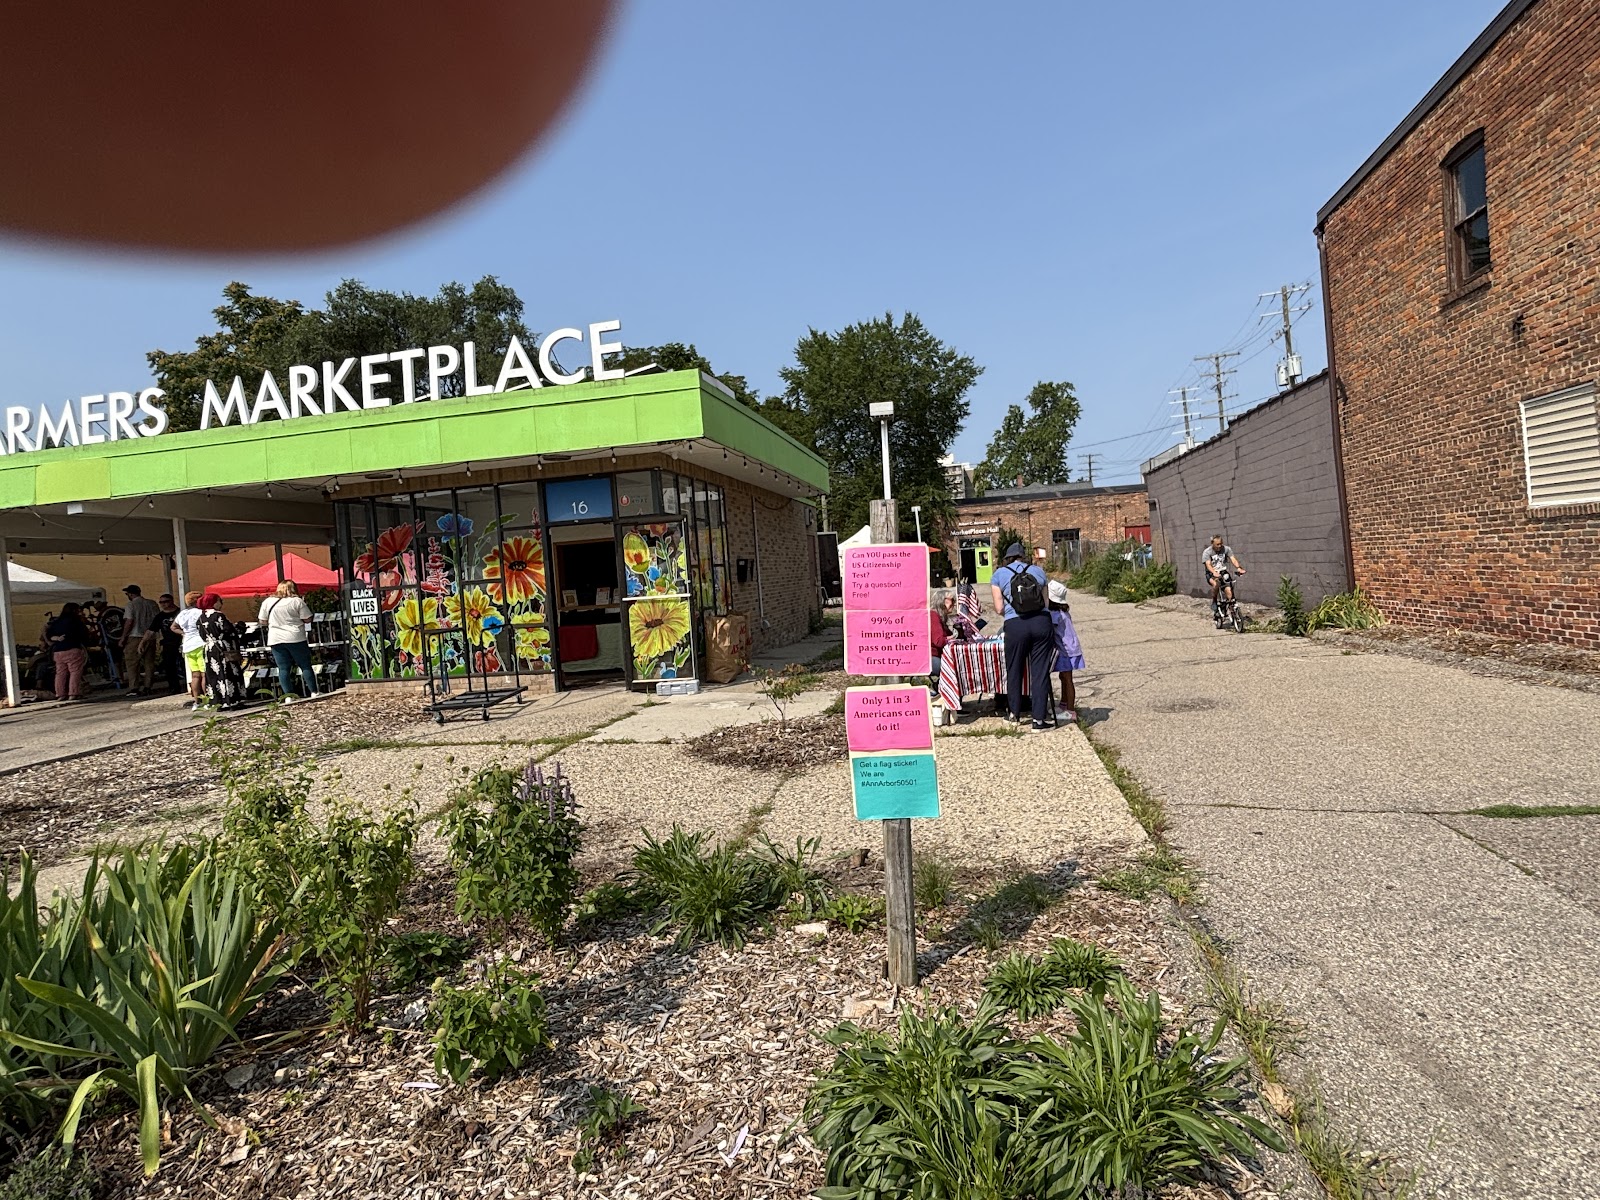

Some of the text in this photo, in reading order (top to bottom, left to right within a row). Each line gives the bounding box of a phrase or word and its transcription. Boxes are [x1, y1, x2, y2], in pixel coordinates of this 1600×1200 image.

[200, 319, 625, 430] MARKETPLACE
[571, 500, 589, 515] 16
[882, 552, 898, 560] pass
[862, 561, 902, 569] Citizenship
[852, 581, 863, 589] Try
[870, 581, 902, 590] question!
[352, 589, 374, 598] BLACK
[352, 600, 375, 613] LIVES
[353, 615, 377, 624] MATTER
[870, 616, 905, 625] 99% of
[861, 630, 914, 640] immigrants
[858, 644, 879, 653] pass
[895, 642, 918, 652] their
[866, 656, 886, 665] first
[862, 695, 911, 706] Only 1 in 3
[853, 709, 903, 719] Americans
[876, 722, 900, 731] do it!
[879, 760, 892, 769] flag
[861, 779, 917, 787] #AnnArbor50501
